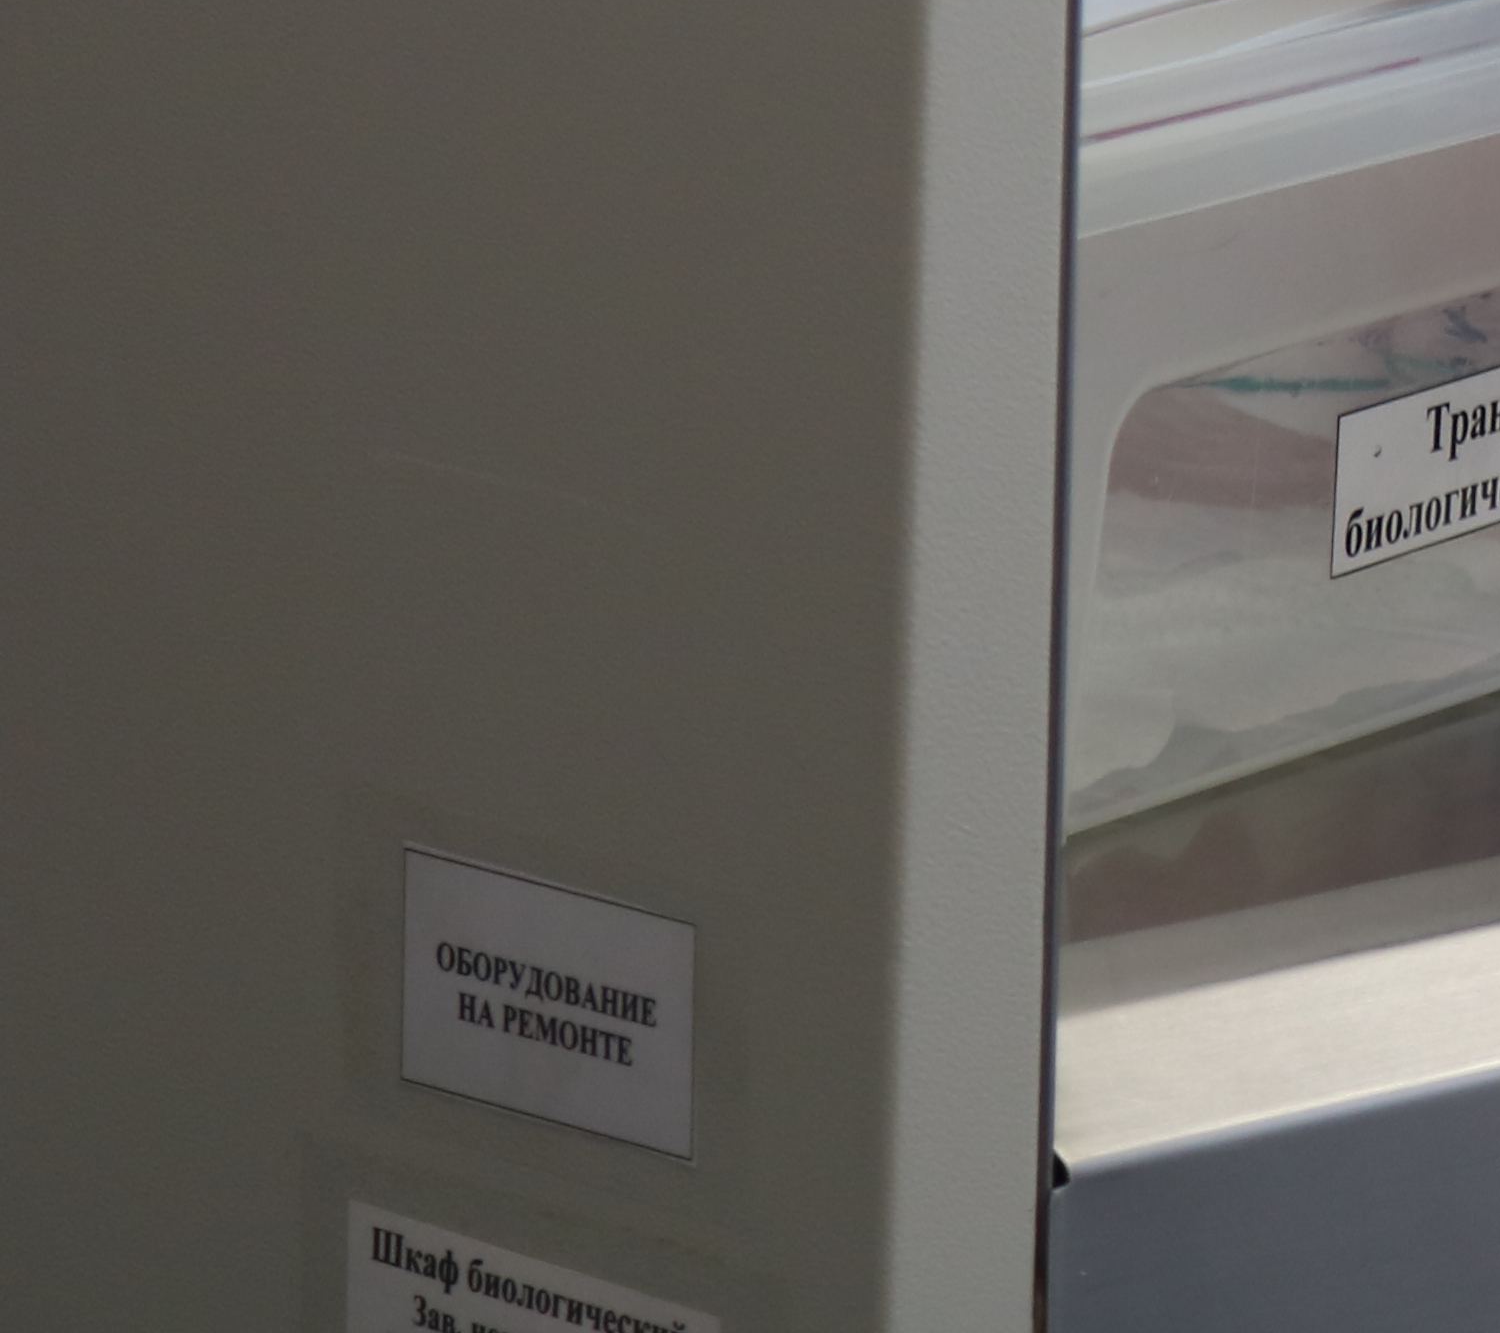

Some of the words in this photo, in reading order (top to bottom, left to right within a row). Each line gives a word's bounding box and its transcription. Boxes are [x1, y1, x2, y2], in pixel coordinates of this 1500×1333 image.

[435, 941, 658, 1028] ОБОРУДОВАНИЕ
[457, 991, 495, 1029] НА
[502, 1003, 633, 1068] РЕМОНТЕ
[371, 1225, 460, 1294] Шкаф
